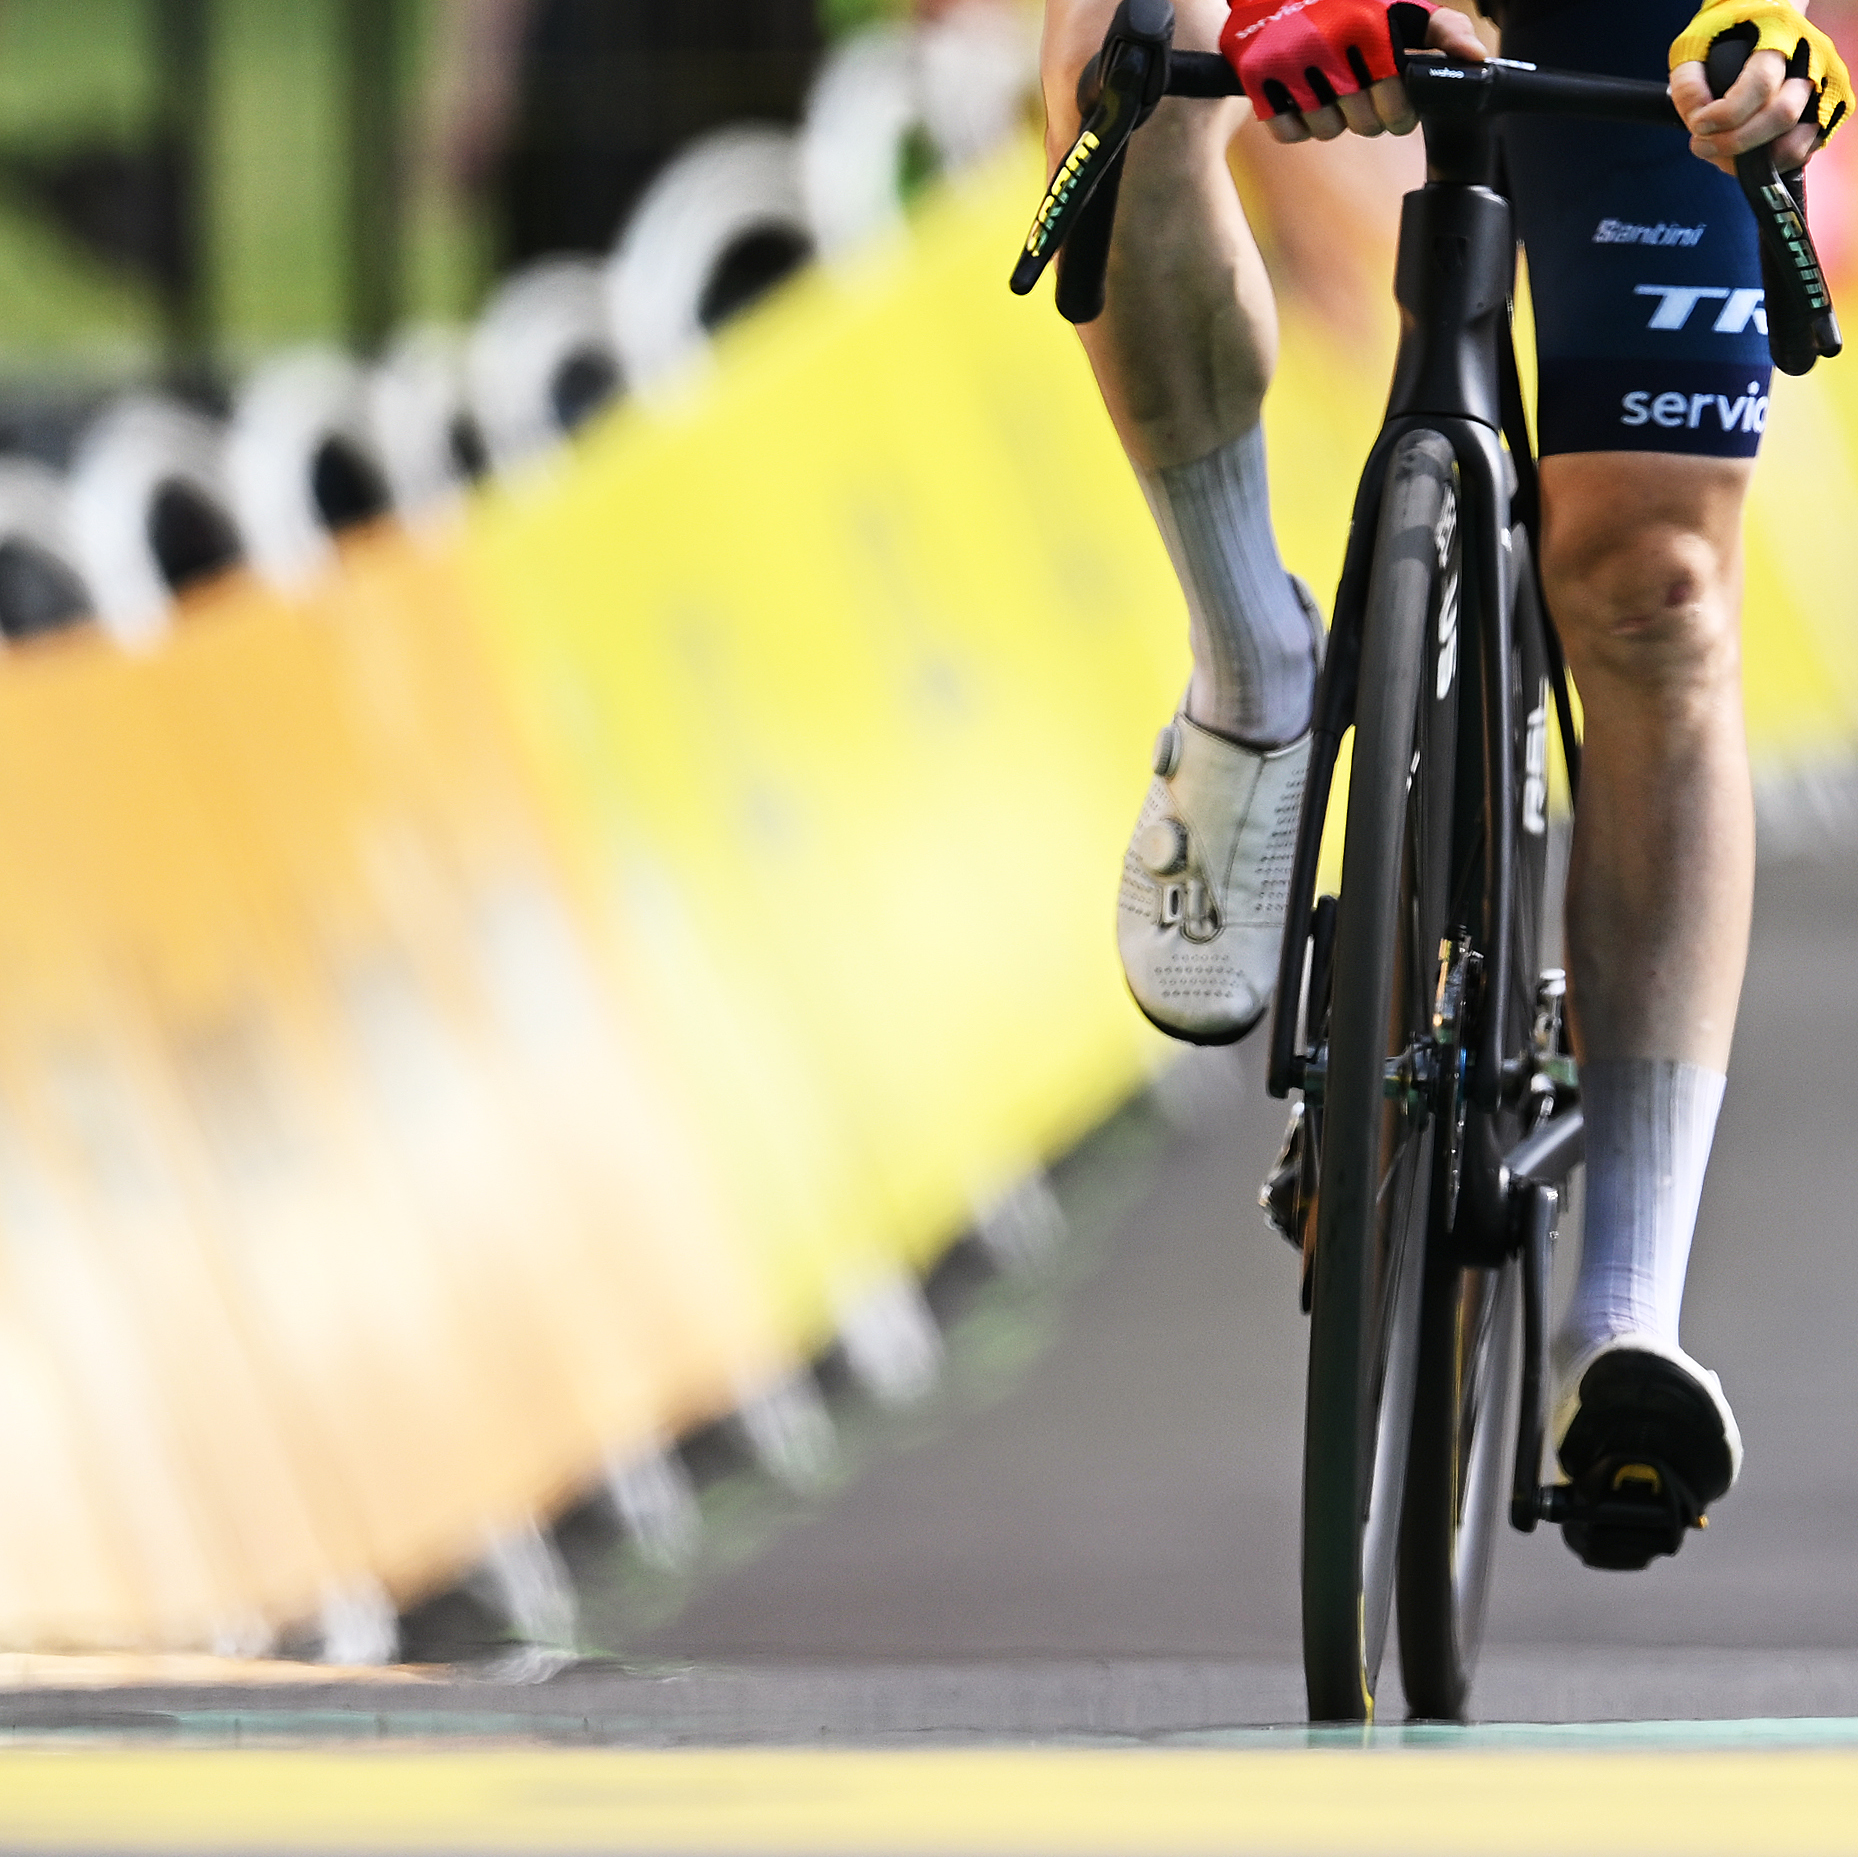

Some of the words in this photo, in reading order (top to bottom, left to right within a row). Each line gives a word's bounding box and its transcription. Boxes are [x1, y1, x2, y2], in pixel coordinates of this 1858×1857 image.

[1026, 130, 1100, 258] SRAM
[1591, 216, 1708, 248] Santini
[1760, 183, 1830, 309] SRAM
[1633, 283, 1770, 336] TR
